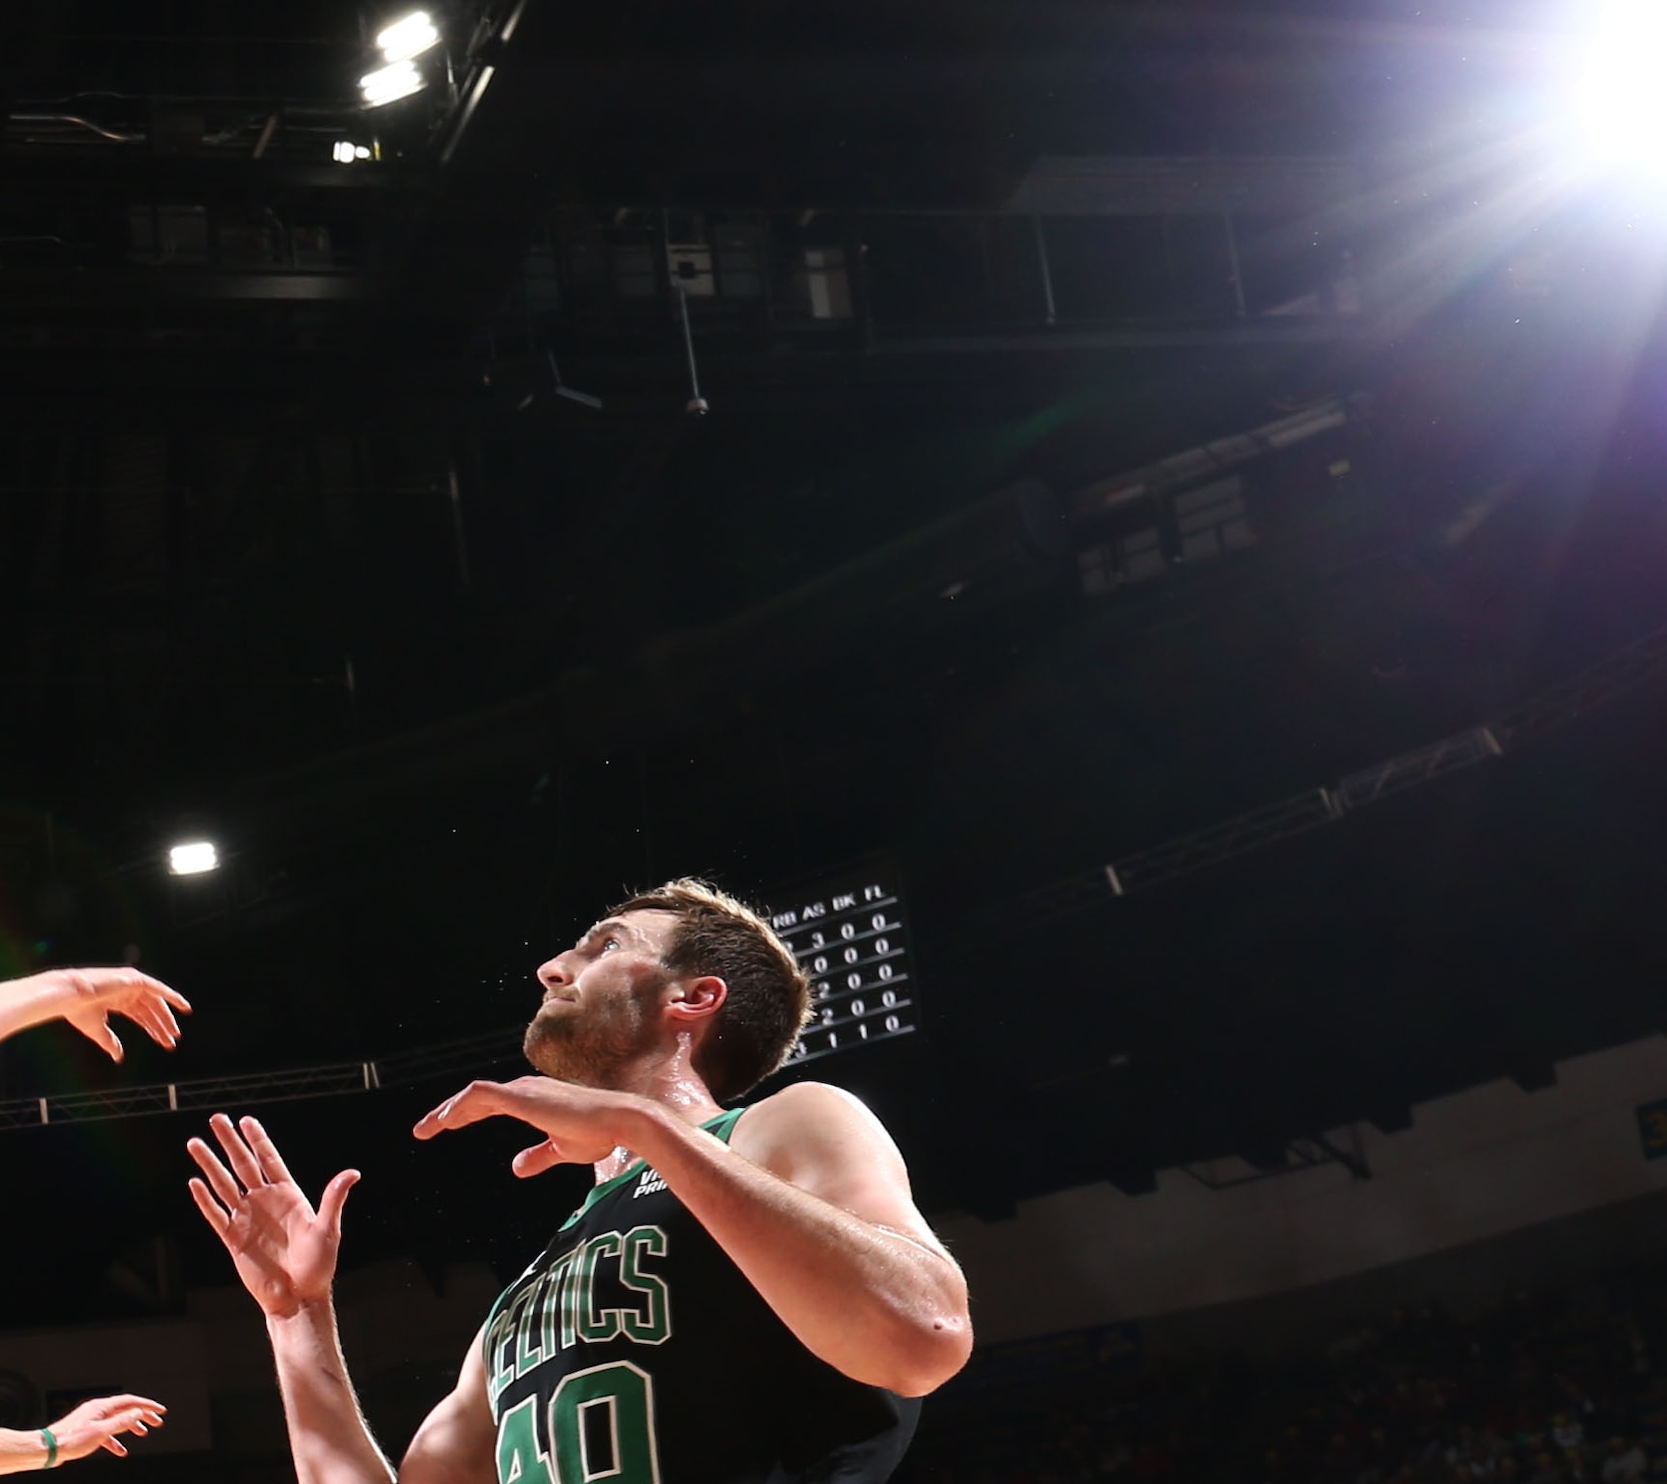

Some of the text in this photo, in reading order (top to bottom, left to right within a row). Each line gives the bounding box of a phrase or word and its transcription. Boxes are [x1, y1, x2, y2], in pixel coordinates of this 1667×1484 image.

[802, 903, 826, 920] AS
[812, 914, 885, 949] 3 0 0
[815, 938, 889, 973] 0 0 0
[818, 964, 892, 999] 2 0 0
[821, 991, 896, 1025] 2 0 0
[886, 1015, 899, 1032] 0
[482, 1224, 672, 1425] CELTICS
